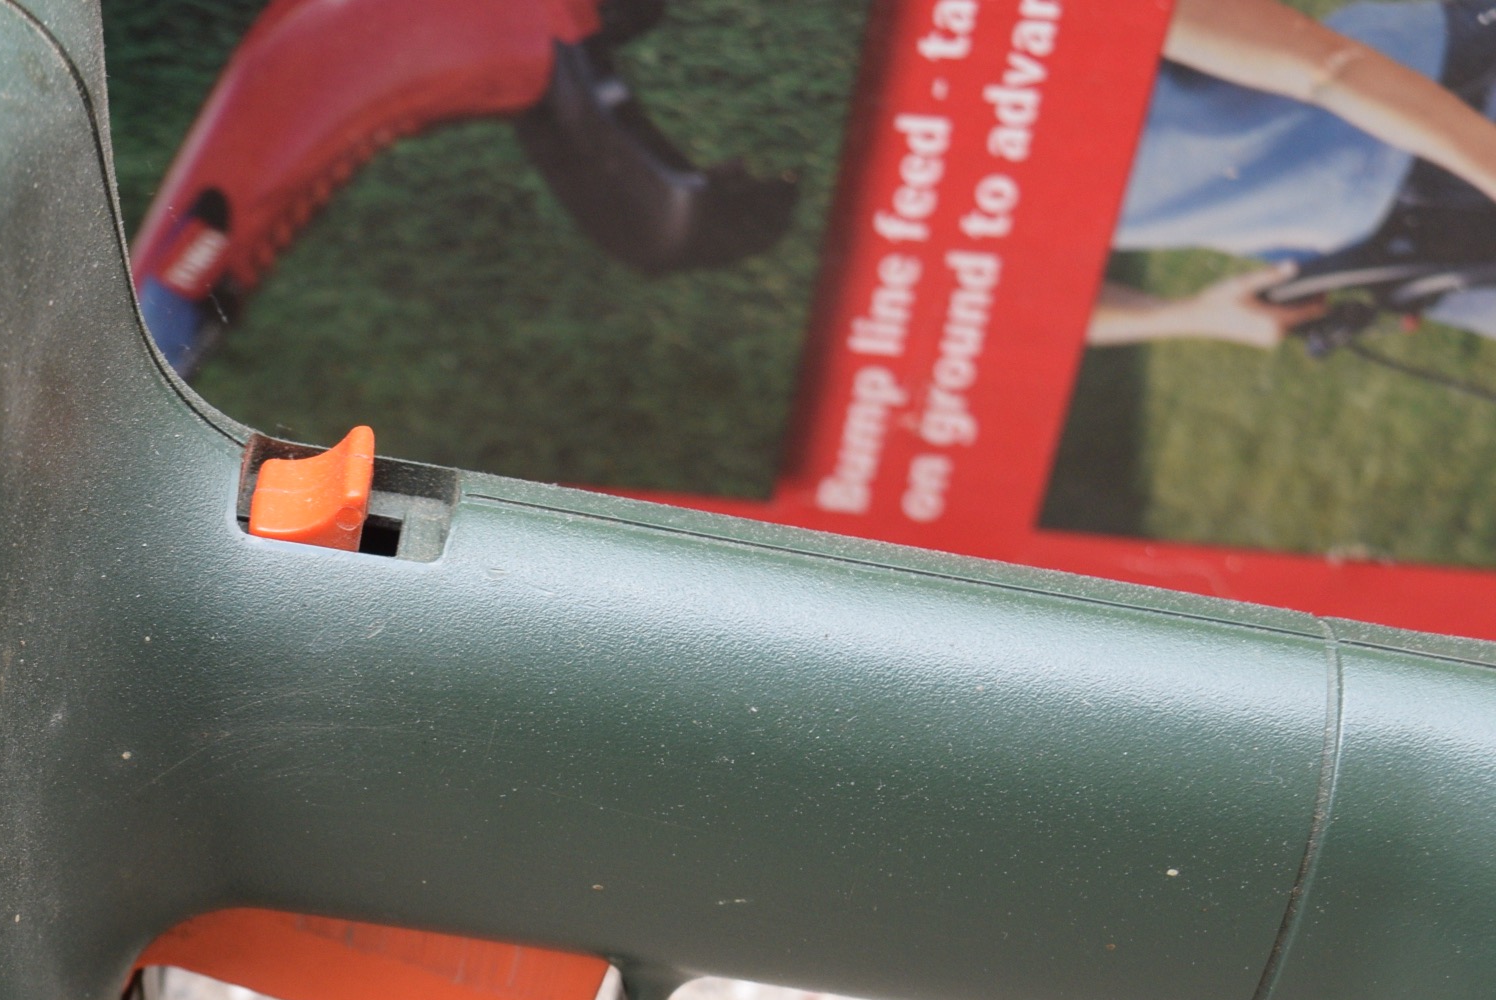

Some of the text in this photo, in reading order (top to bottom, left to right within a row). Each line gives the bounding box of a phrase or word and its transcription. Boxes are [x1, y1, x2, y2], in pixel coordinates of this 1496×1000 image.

[874, 114, 953, 241] feed
[961, 174, 1020, 239] to
[849, 255, 921, 356] line
[920, 251, 1001, 445] ground
[816, 366, 906, 514] Bump
[902, 455, 953, 522] on
